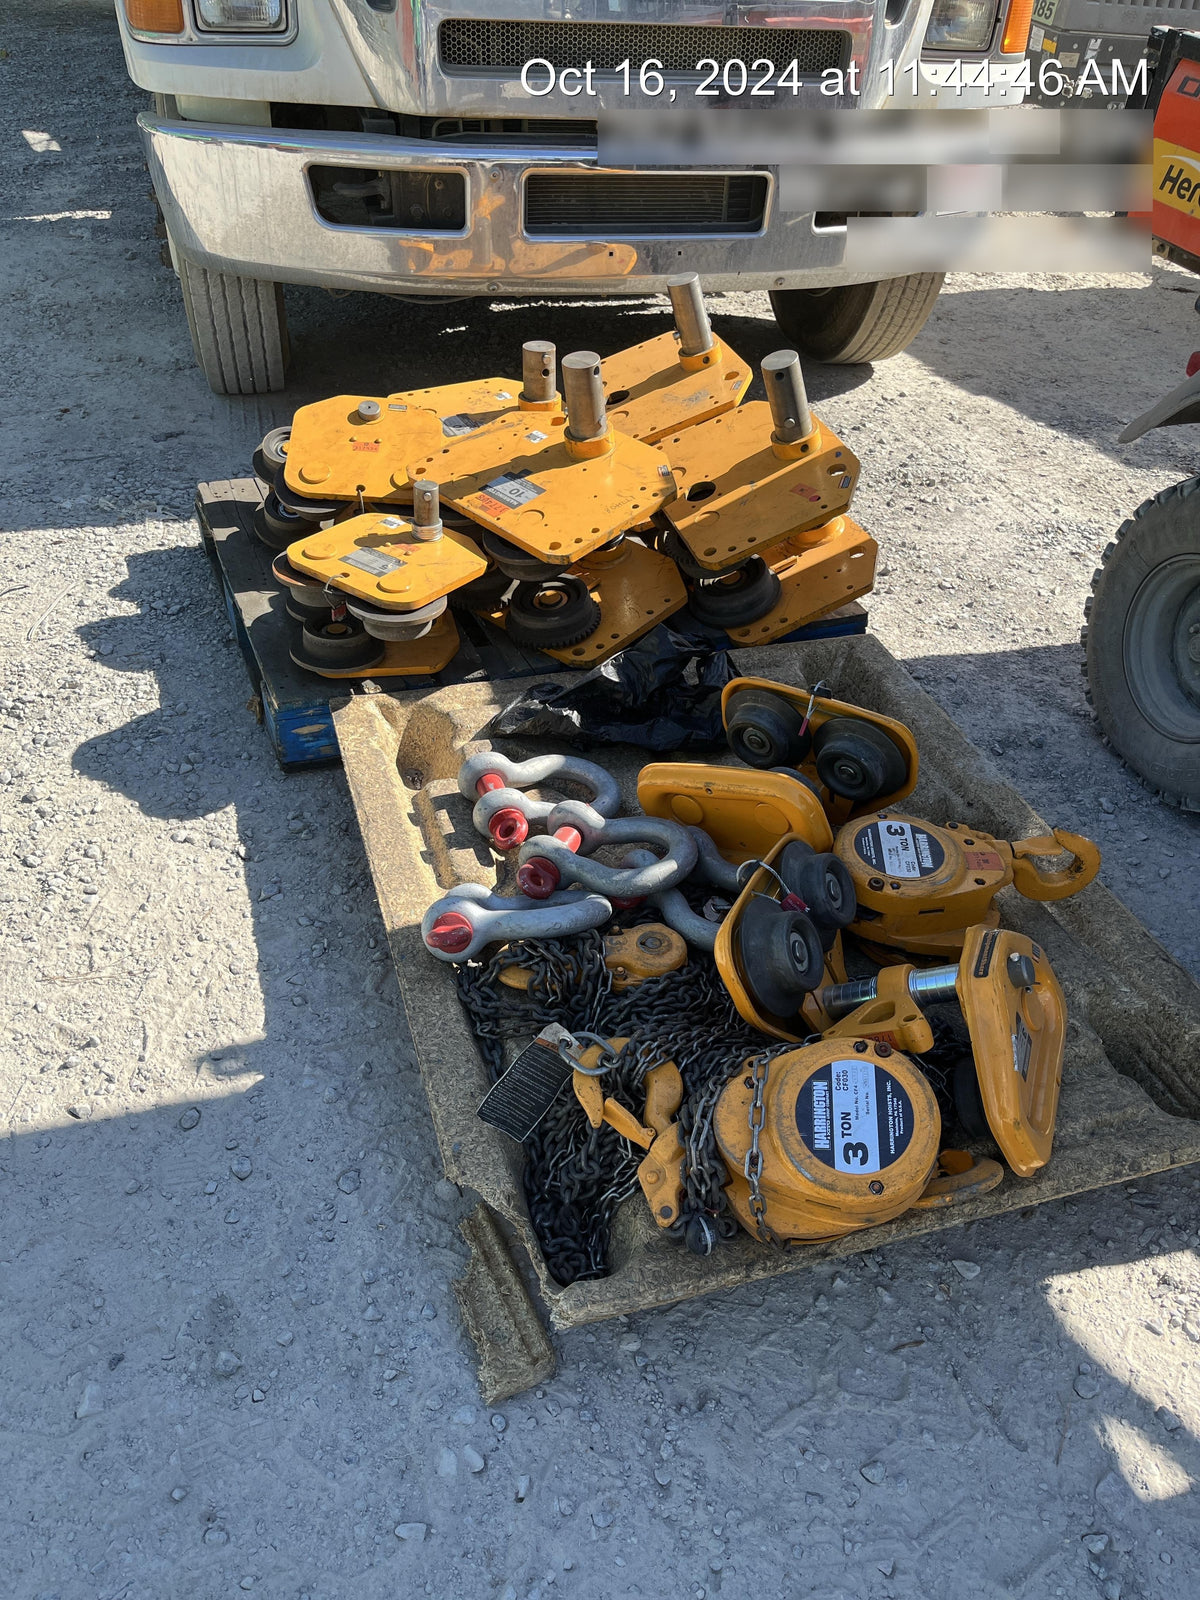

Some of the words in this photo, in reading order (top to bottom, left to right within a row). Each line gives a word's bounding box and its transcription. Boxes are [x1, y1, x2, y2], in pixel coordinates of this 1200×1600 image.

[509, 488, 525, 498] 10
[886, 824, 906, 837] 3
[900, 837, 910, 852] TON
[841, 1069, 849, 1091] CF030
[812, 1081, 830, 1149] HARRINGTON
[840, 1111, 852, 1139] TON
[843, 1141, 869, 1166] 3
